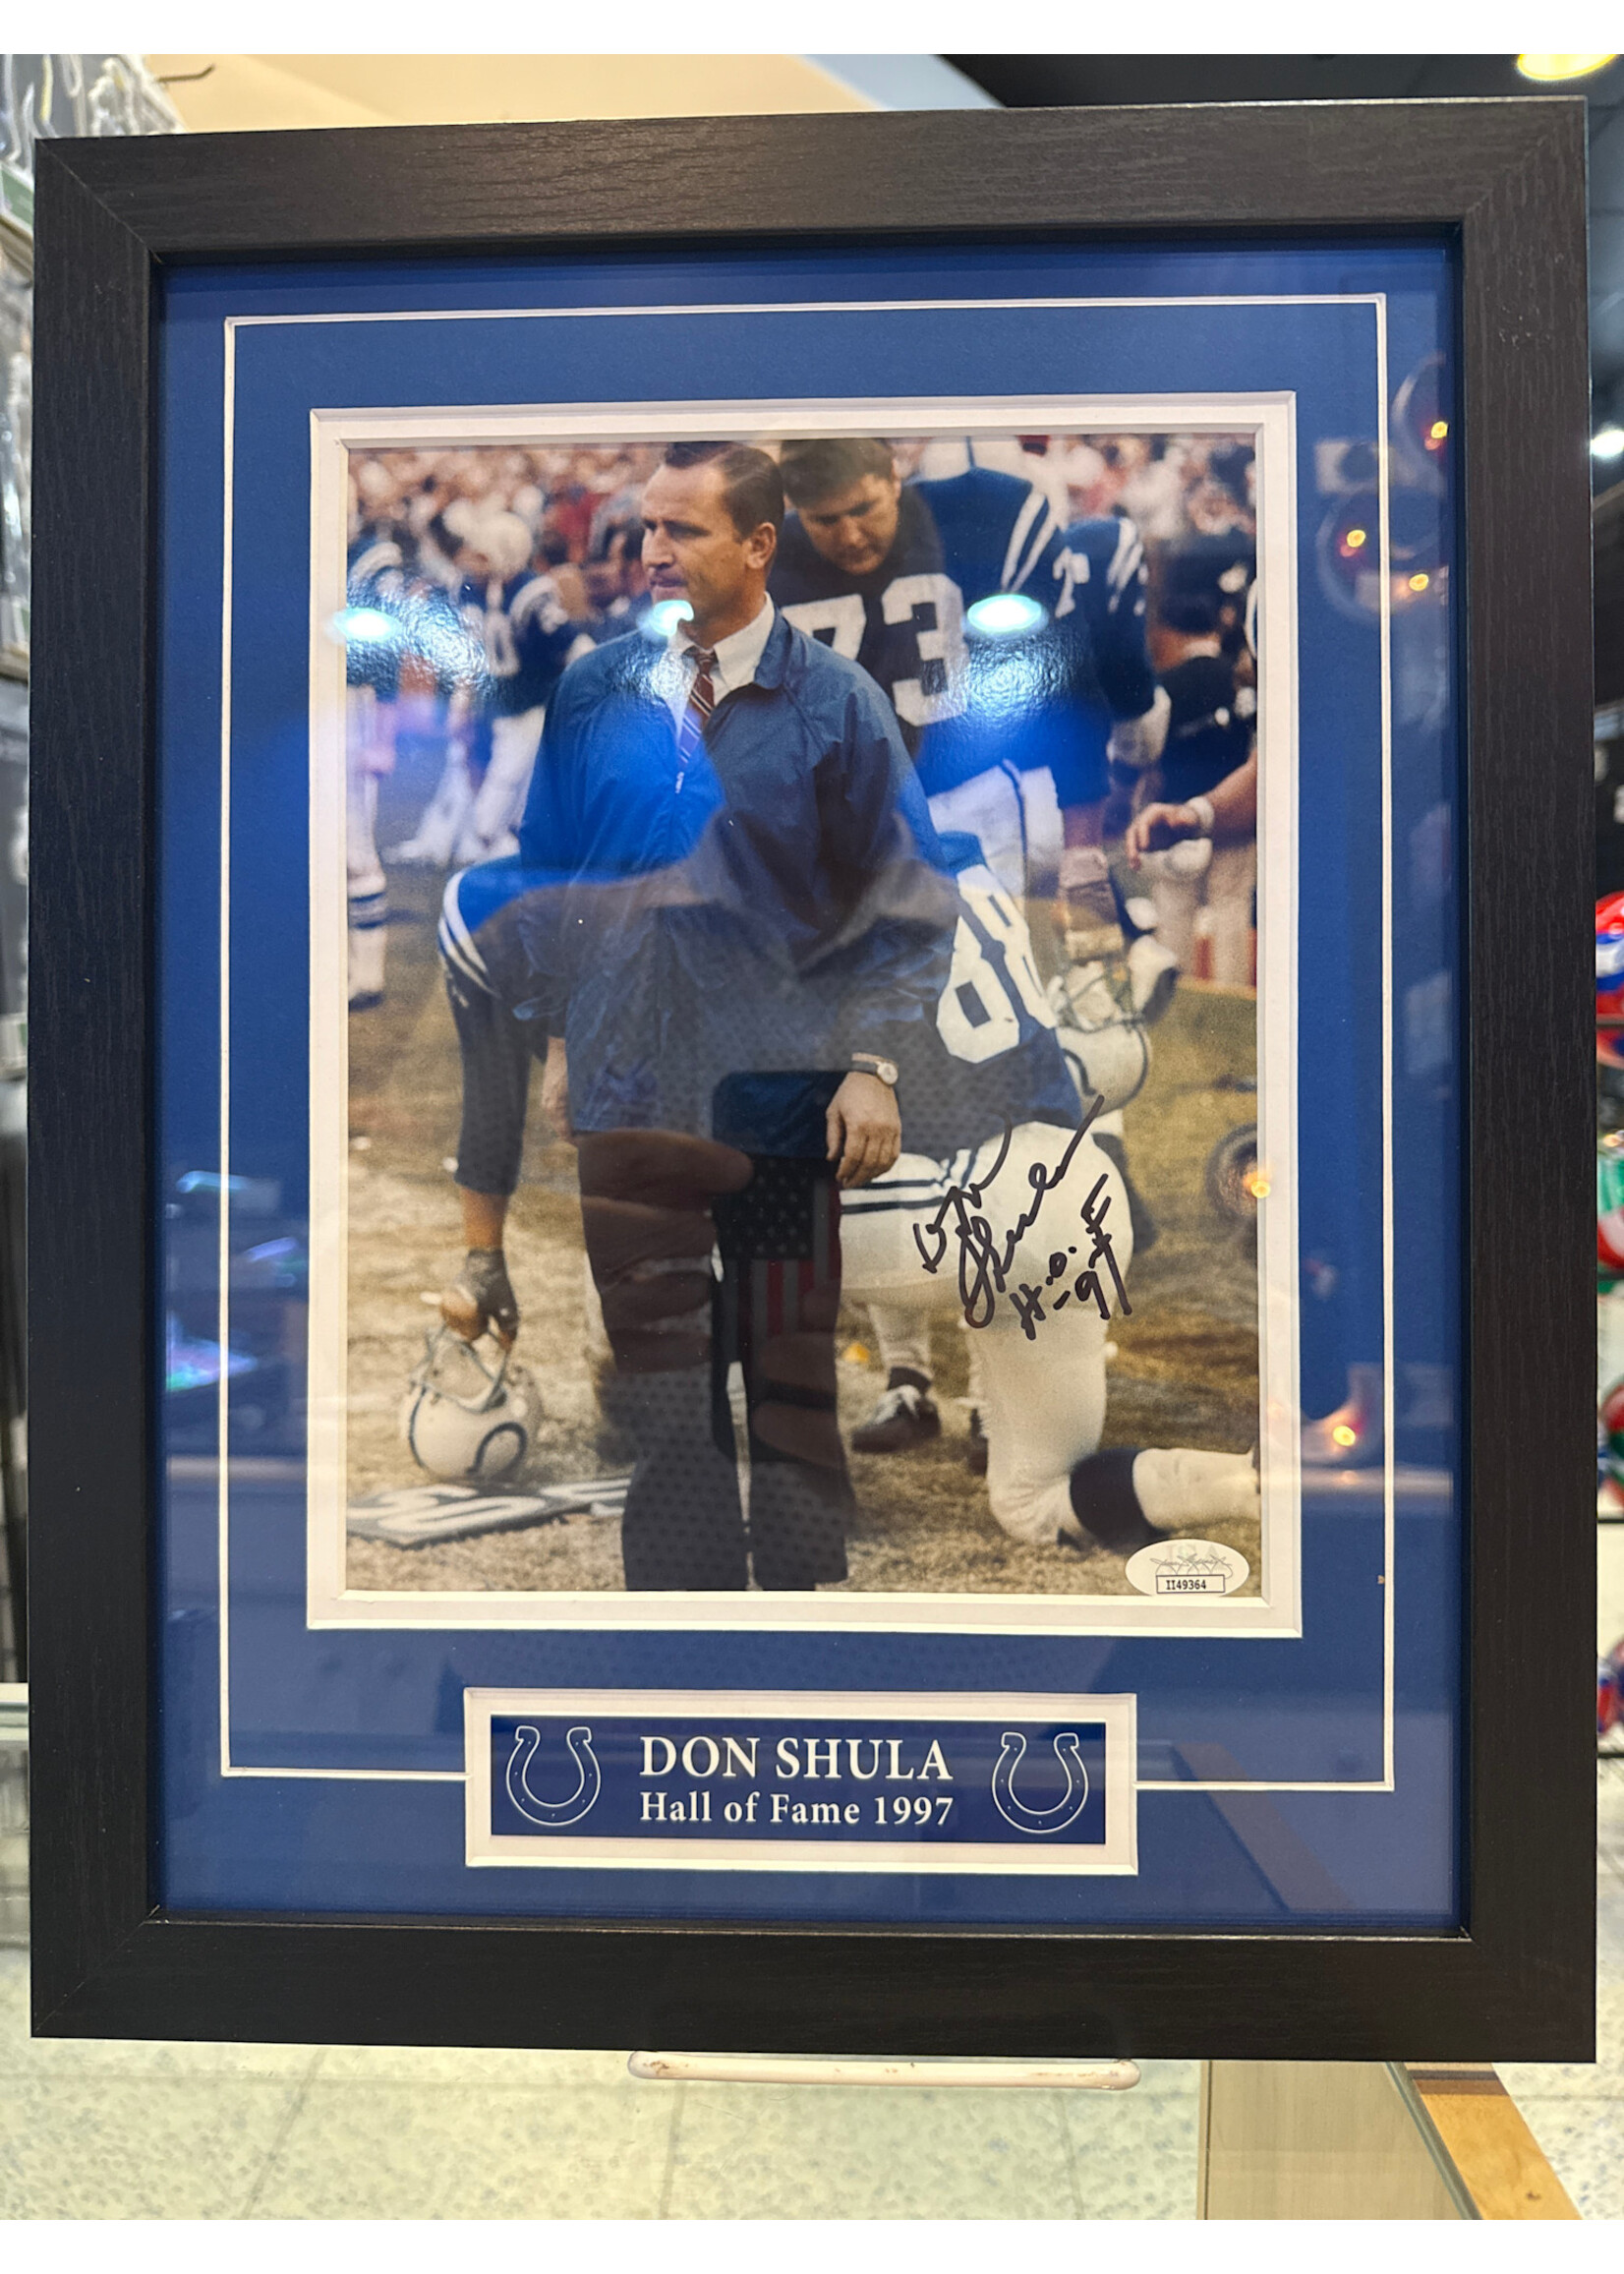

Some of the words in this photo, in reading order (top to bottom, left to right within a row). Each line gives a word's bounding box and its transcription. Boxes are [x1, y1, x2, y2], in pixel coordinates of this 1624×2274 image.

[781, 565, 970, 727] 73
[936, 864, 1059, 1064] 88
[1166, 1579, 1207, 1591] II49364
[639, 1735, 761, 1778] DON
[775, 1737, 955, 1780] SHULA
[639, 1789, 713, 1822] Hall
[724, 1790, 761, 1823] of
[769, 1792, 861, 1826] Fame
[874, 1796, 955, 1826] 1997
